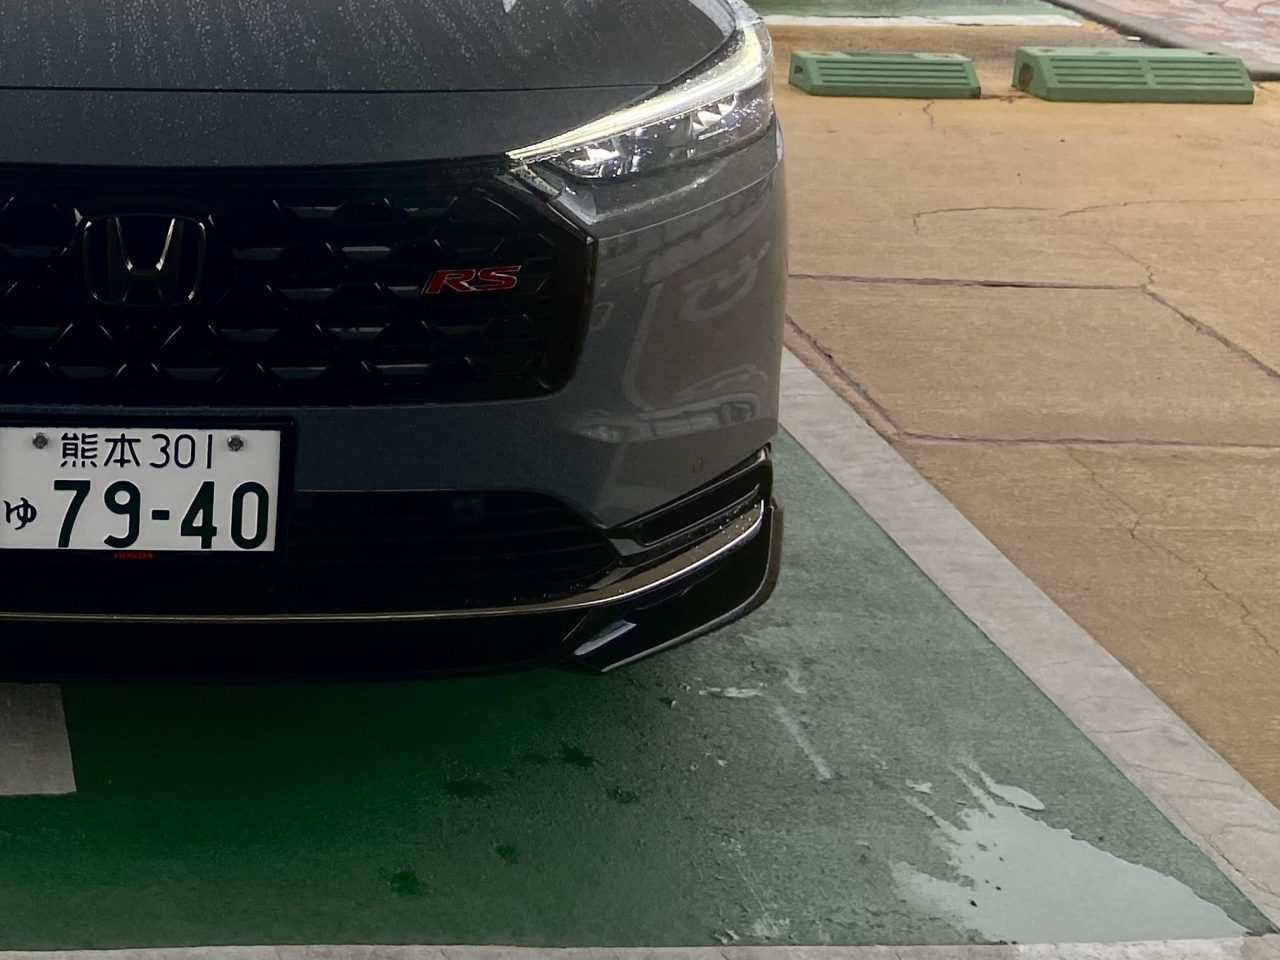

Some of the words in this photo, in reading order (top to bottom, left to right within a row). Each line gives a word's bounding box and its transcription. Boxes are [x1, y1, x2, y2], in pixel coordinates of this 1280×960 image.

[421, 265, 521, 294] RS
[3, 497, 38, 530] ゆ
[53, 479, 270, 550] 79-40
